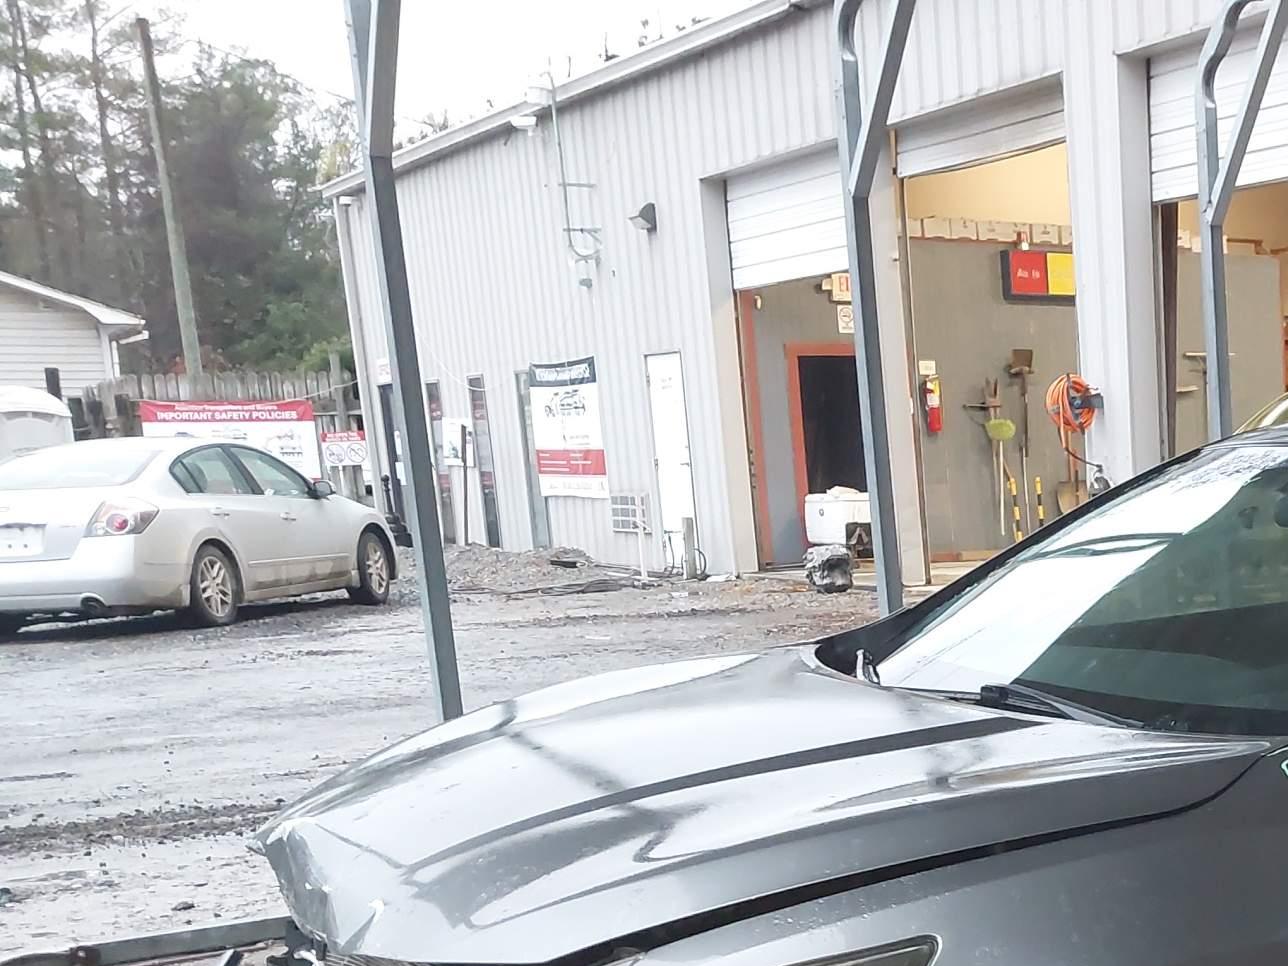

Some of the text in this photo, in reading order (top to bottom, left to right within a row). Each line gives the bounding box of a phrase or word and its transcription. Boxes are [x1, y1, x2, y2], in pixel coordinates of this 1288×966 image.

[157, 411, 298, 421] IMPORTANT SAFETY POLICIES
